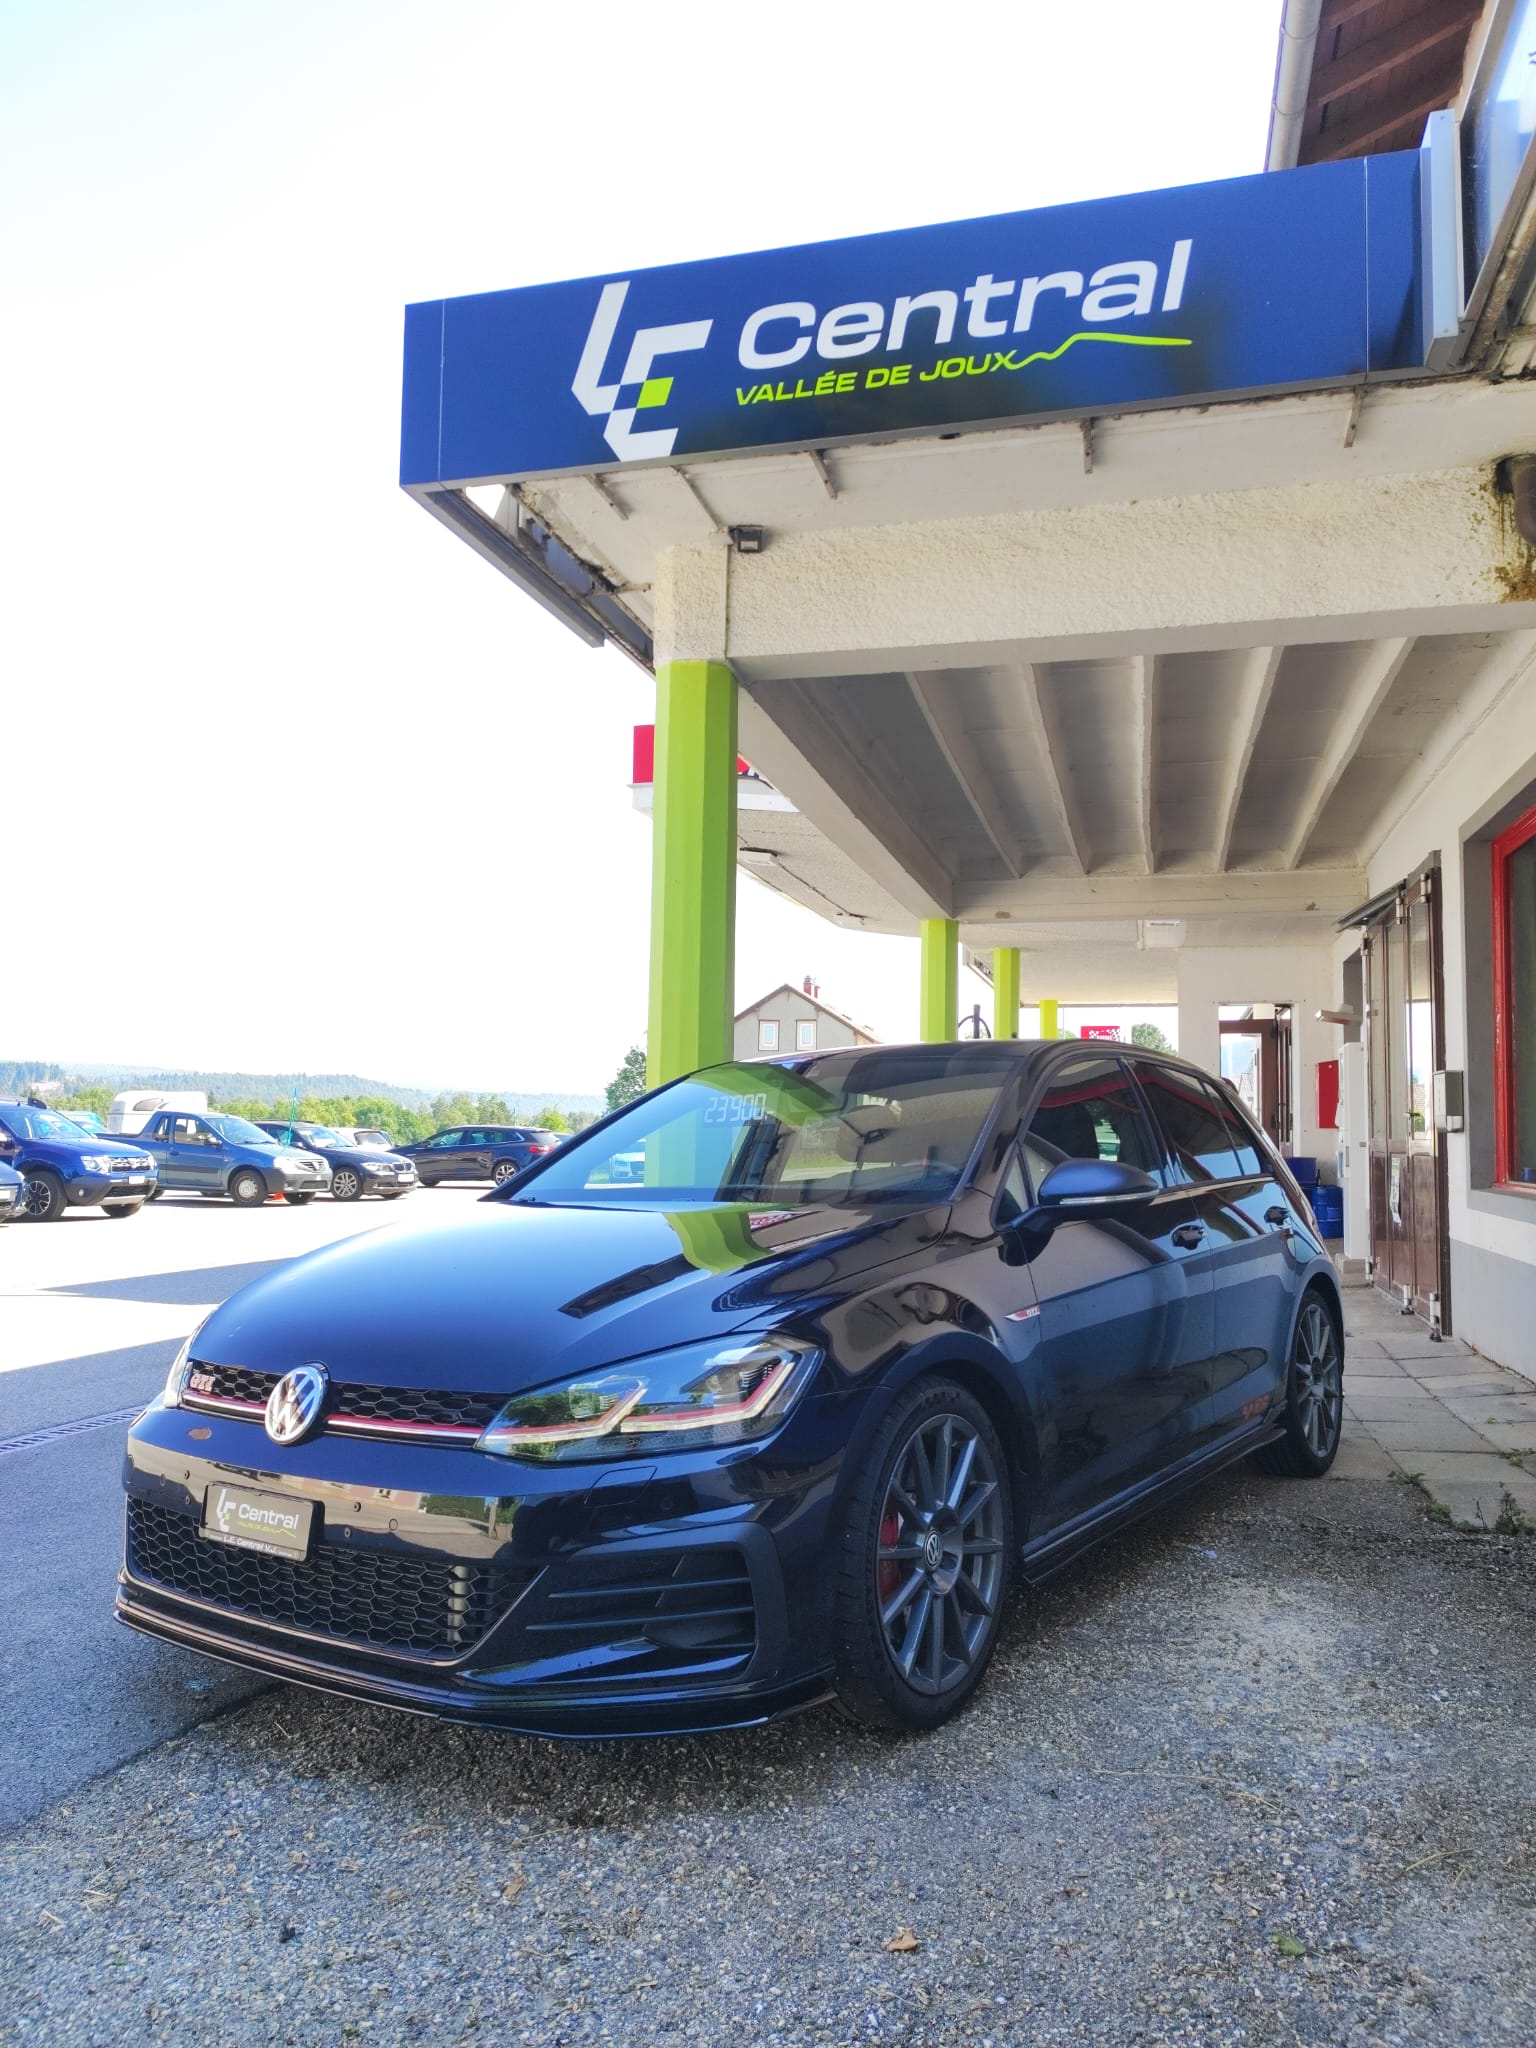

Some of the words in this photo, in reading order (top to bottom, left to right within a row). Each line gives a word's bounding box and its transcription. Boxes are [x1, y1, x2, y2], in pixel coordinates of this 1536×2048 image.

[738, 239, 1193, 371] Central
[736, 371, 857, 405] VALLÉE
[865, 364, 912, 389] DE
[920, 349, 1018, 381] JOUX
[239, 1503, 299, 1530] Central
